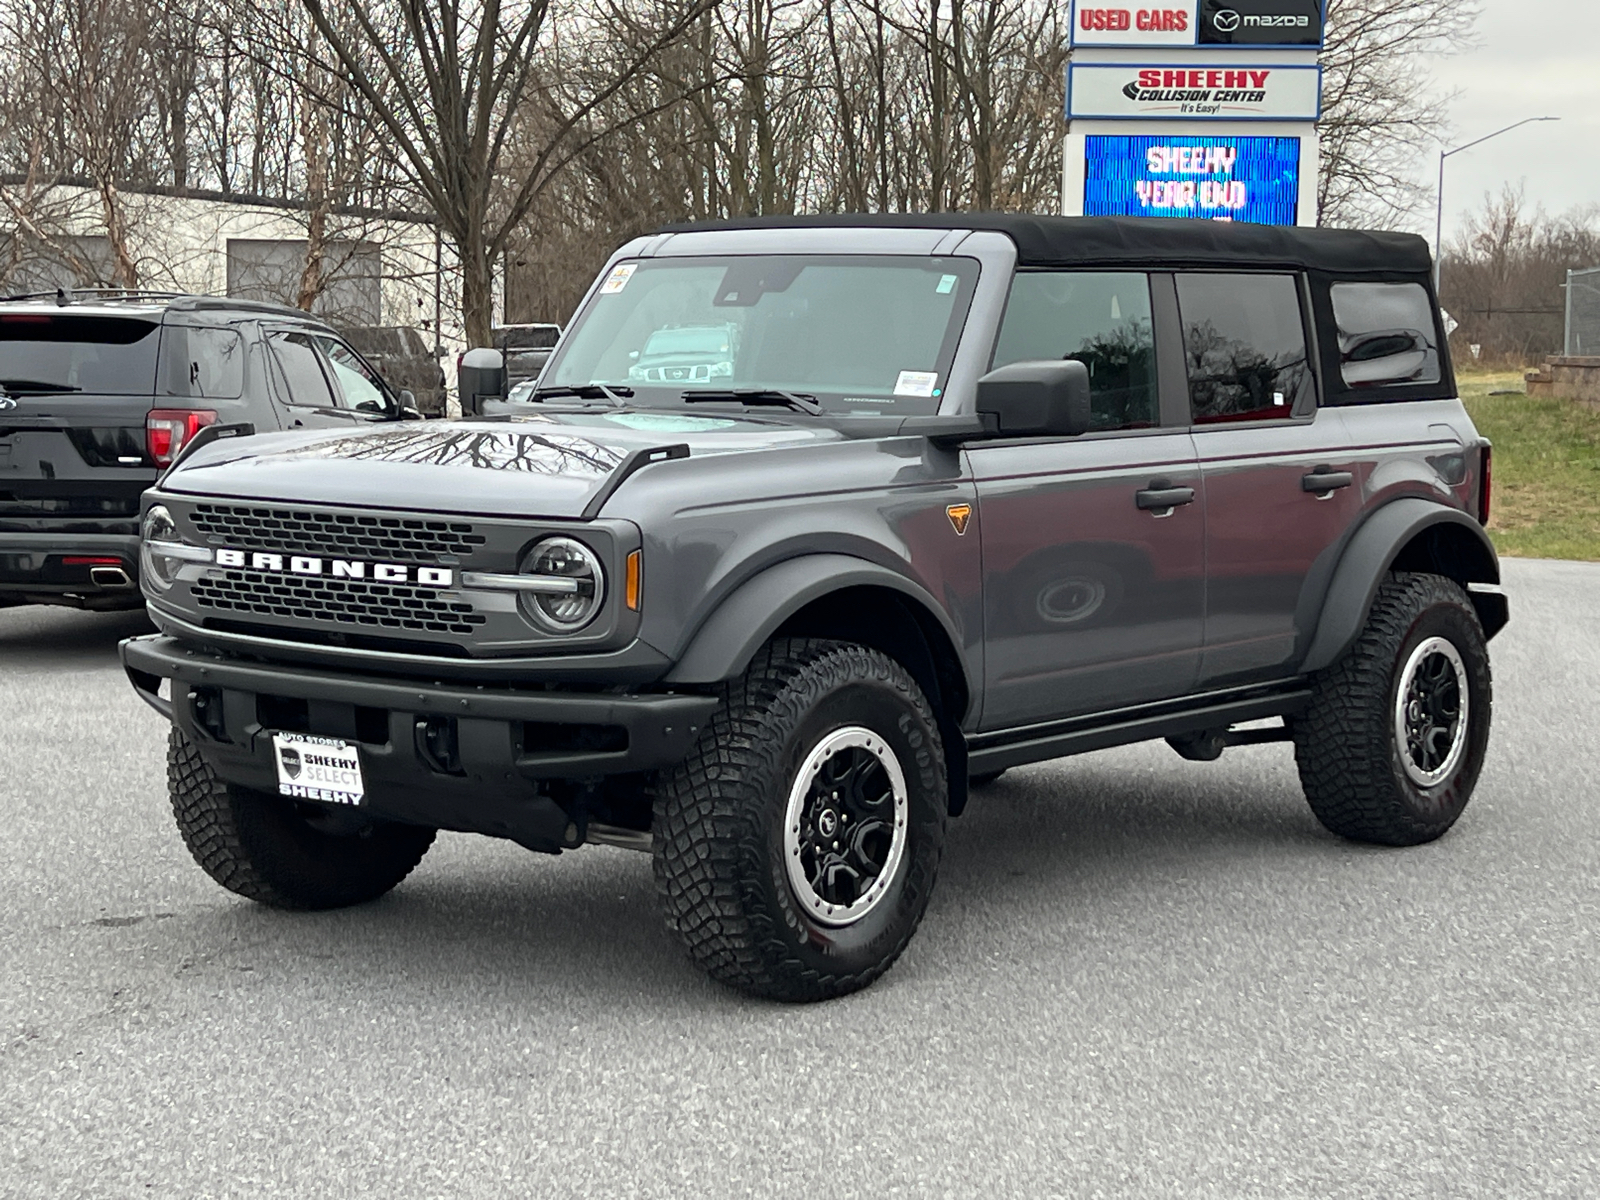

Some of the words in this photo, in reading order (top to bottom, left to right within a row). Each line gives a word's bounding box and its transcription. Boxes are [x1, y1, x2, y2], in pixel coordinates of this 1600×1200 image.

[1080, 9, 1130, 31] USED
[1136, 9, 1188, 31] CARS
[1138, 70, 1270, 88] SHEEHY
[1137, 89, 1211, 102] COLLISION
[1213, 90, 1266, 102] CENTER
[1180, 103, 1194, 113] It's
[1196, 103, 1220, 114] Easy!
[1147, 146, 1236, 173] SHEEHY
[1136, 180, 1195, 208] YEAR
[1200, 180, 1246, 209] END
[216, 548, 453, 586] BRONCO
[304, 753, 357, 770] SHEEHY
[306, 766, 359, 786] SELECT
[279, 783, 363, 806] SHEEHY
